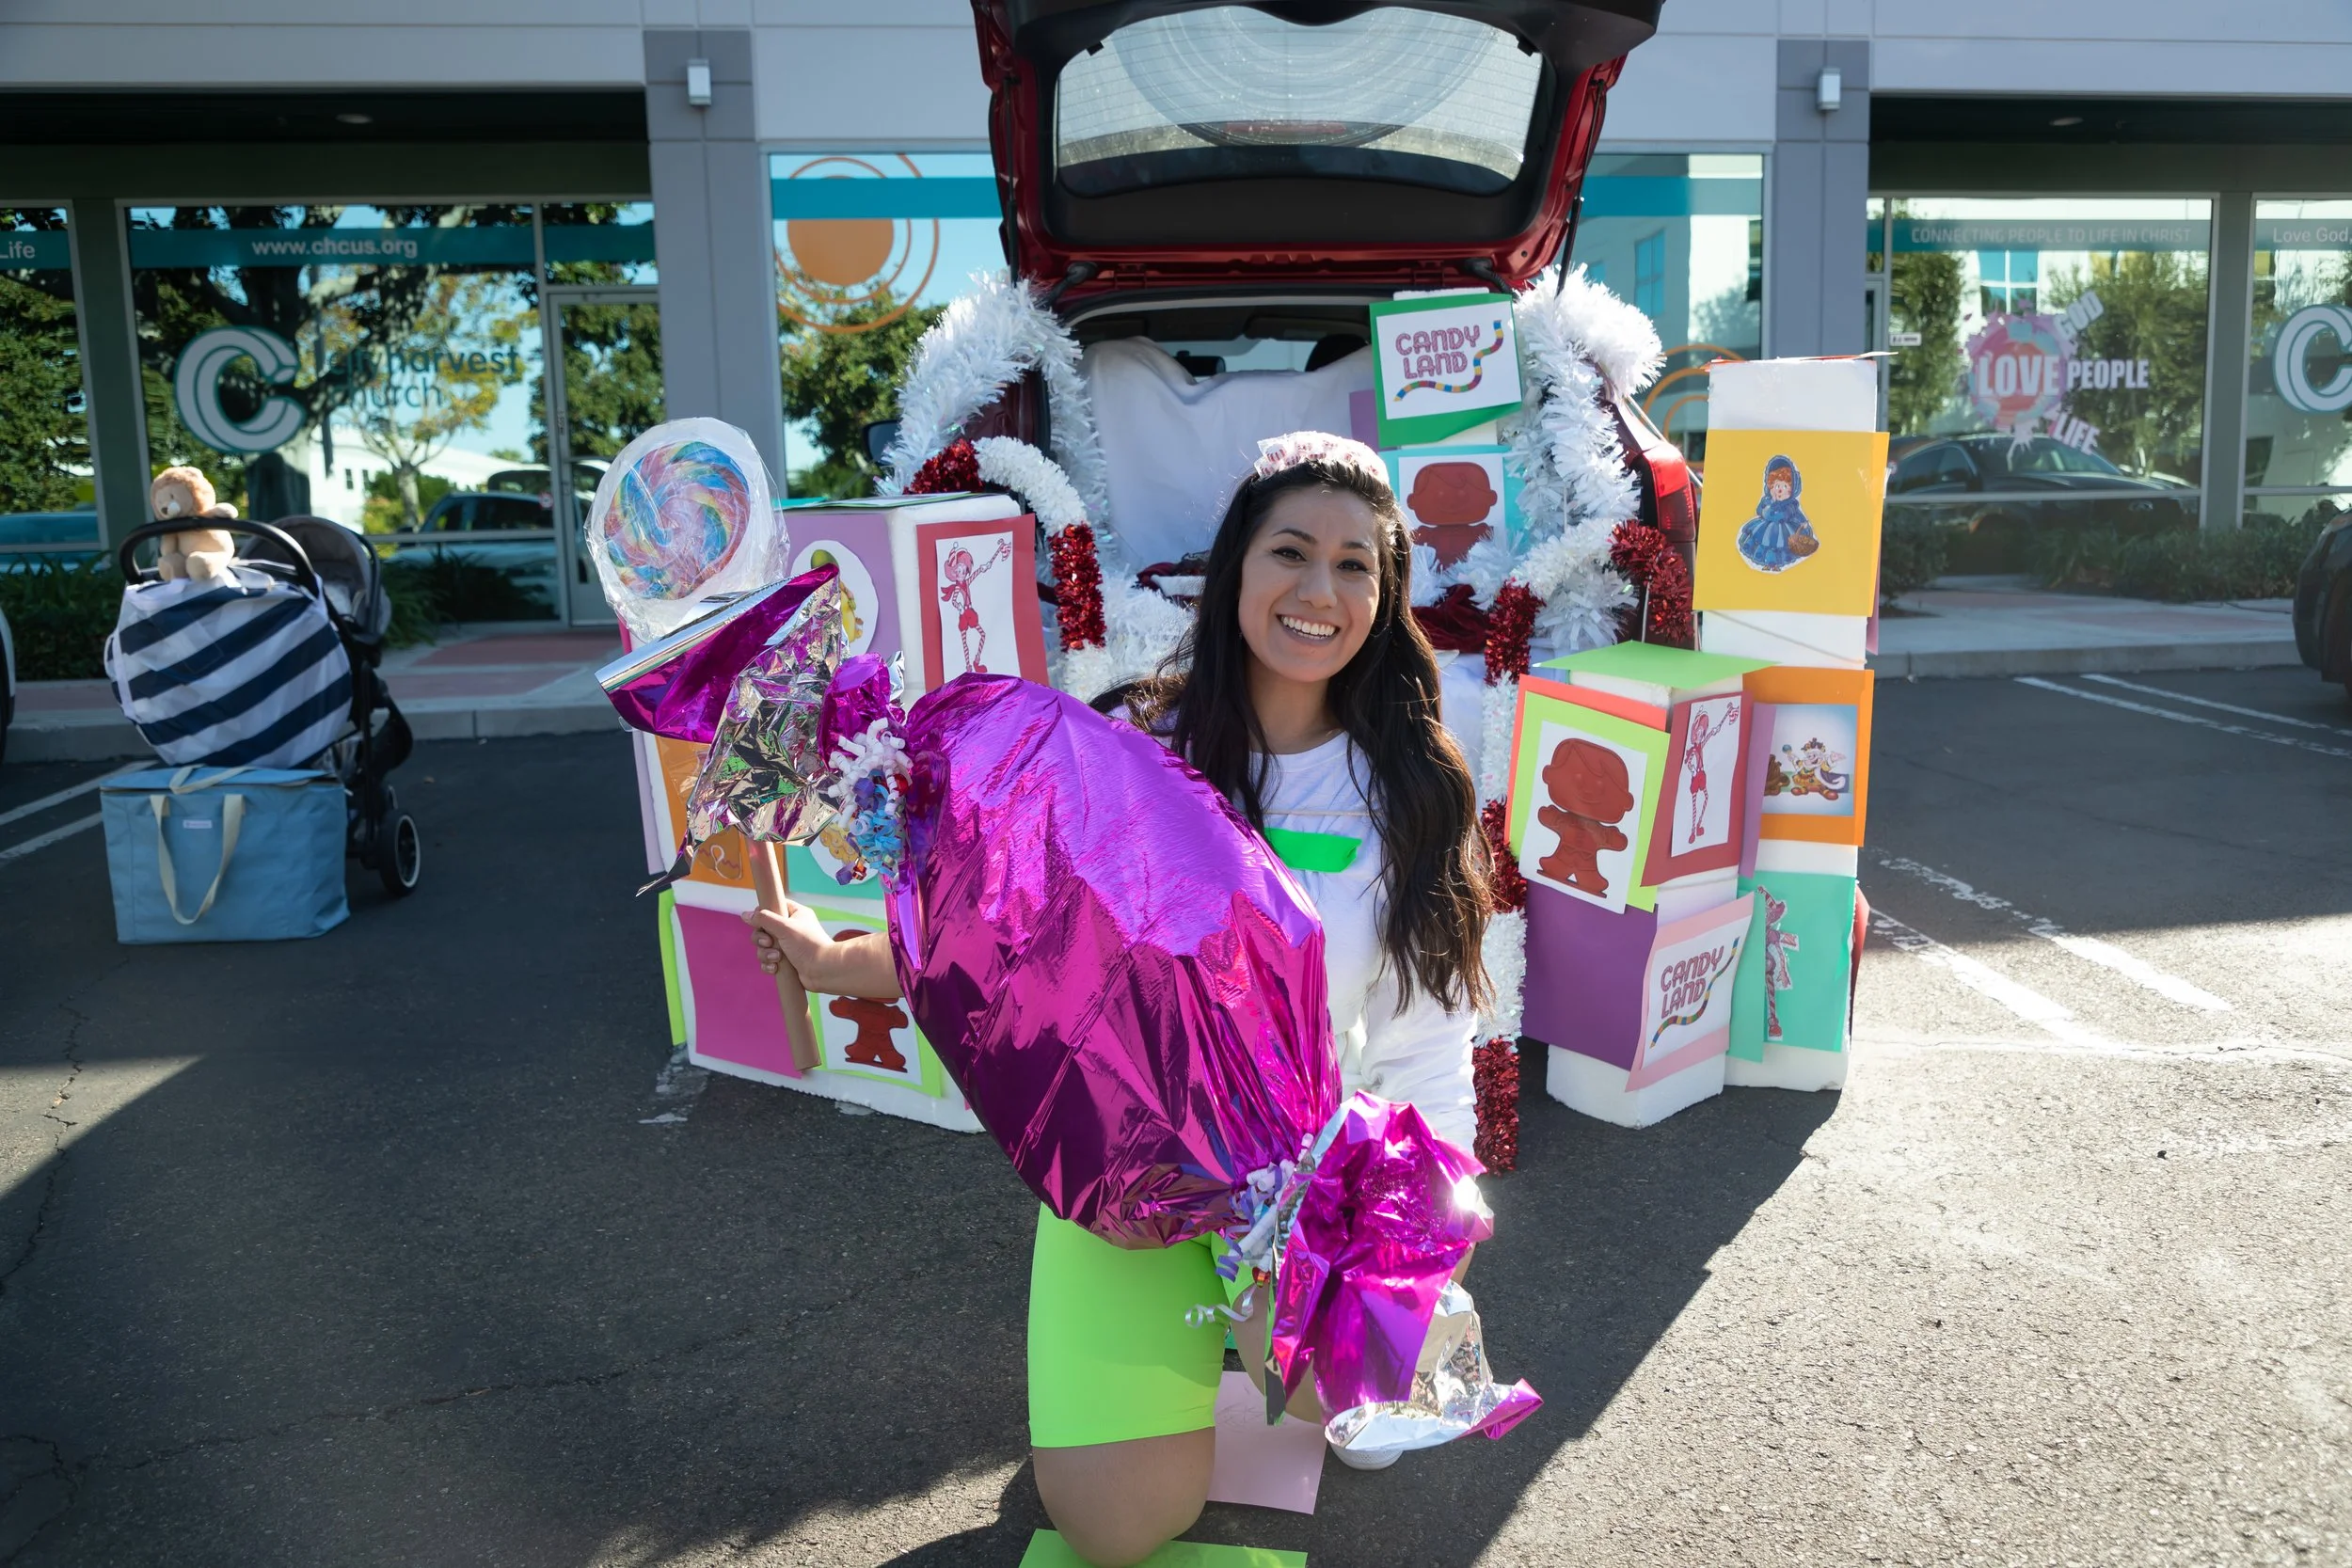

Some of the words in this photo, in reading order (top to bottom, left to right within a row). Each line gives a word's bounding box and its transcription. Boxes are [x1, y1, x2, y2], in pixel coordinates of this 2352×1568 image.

[251, 236, 419, 260] www.chcus.org
[1911, 227, 2005, 244] CONNECTING
[2009, 227, 2063, 244] PEOPLE
[2067, 227, 2086, 243] TO
[2089, 227, 2117, 243] LIFE
[2122, 227, 2137, 243] IN
[2141, 227, 2192, 243] CHRIST
[2273, 227, 2312, 243] Love
[2052, 290, 2105, 341] GOD
[1395, 325, 1481, 356] CANDY
[1403, 351, 1469, 380] LAND
[1979, 354, 2061, 397] LOVE
[2067, 357, 2150, 390] PEOPLE
[330, 378, 442, 408] church
[2052, 413, 2101, 456] LIFE
[1661, 944, 1724, 993] CANDY
[1661, 977, 1707, 1020] LAND
